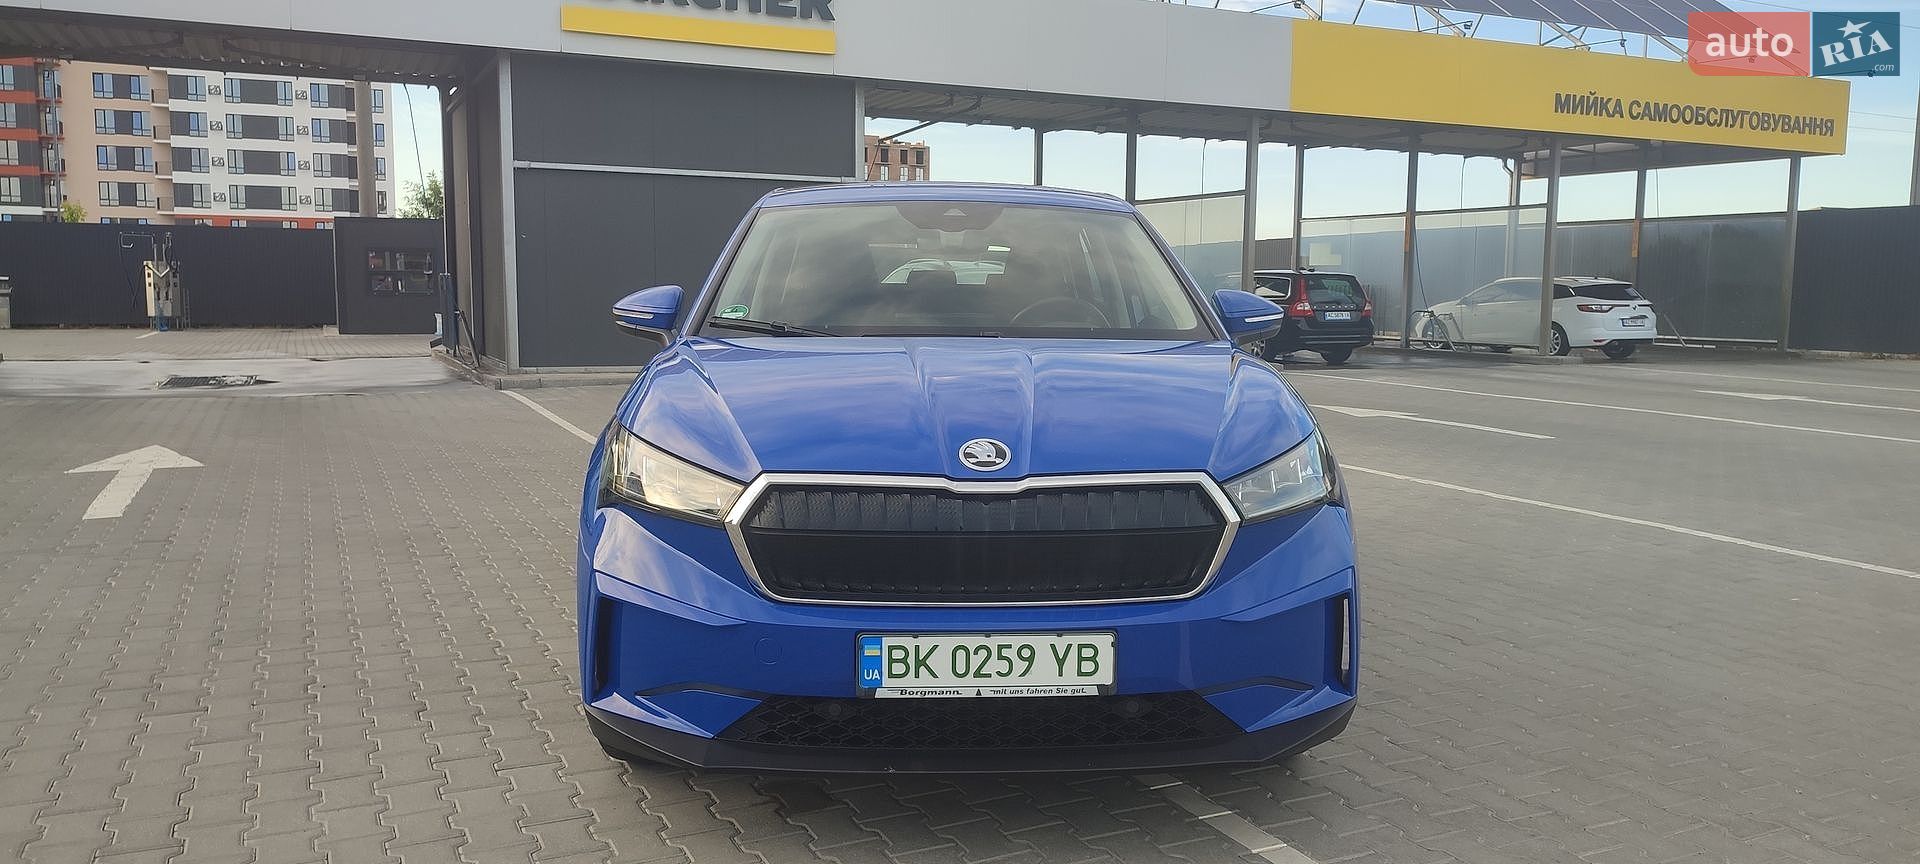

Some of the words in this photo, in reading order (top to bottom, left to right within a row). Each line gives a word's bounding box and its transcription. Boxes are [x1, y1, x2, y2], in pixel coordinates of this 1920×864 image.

[1554, 90, 1624, 119] МИЙКА
[1628, 100, 1835, 137] САМООБСЛУГОВУВАННЯ
[887, 644, 940, 679] BK
[951, 643, 1036, 679] 0259
[1050, 643, 1100, 677] YB
[864, 669, 880, 680] UA
[1026, 687, 1054, 695] fahren
